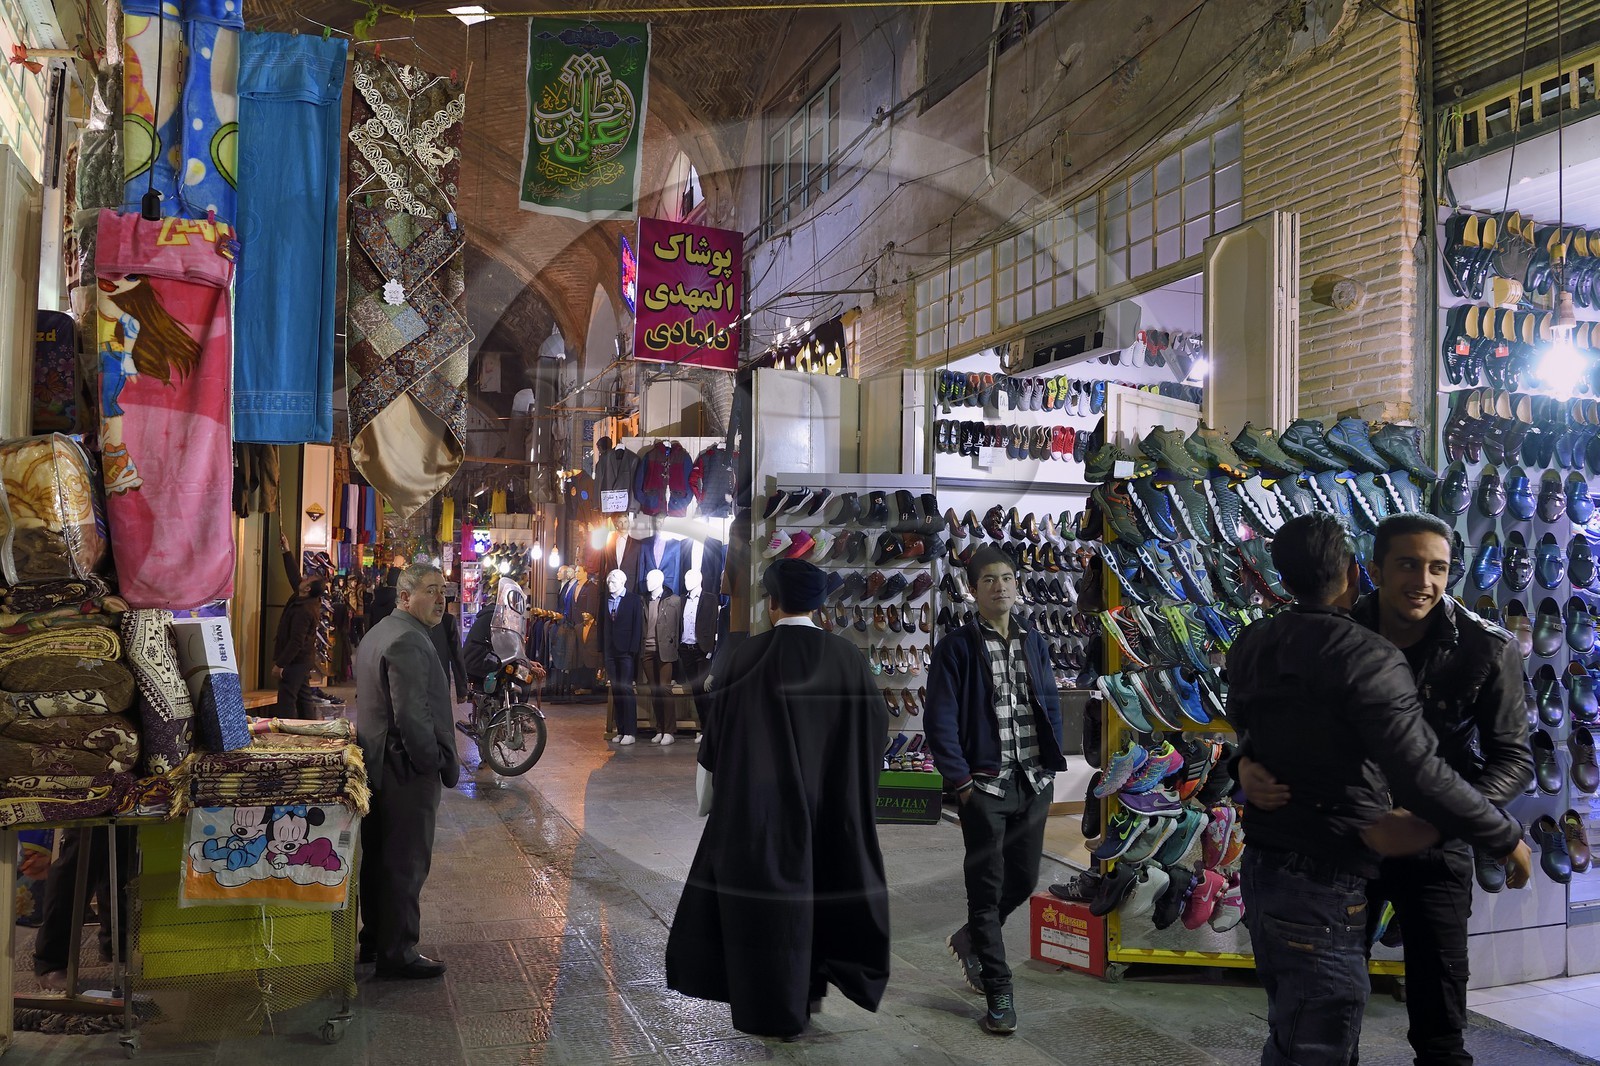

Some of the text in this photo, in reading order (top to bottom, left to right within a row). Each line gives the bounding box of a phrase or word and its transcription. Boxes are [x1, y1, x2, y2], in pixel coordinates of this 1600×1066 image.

[653, 233, 733, 279] پوشاک
[644, 281, 734, 313] المهدی
[644, 317, 730, 351] دامادی
[215, 624, 228, 662] BEH TAN
